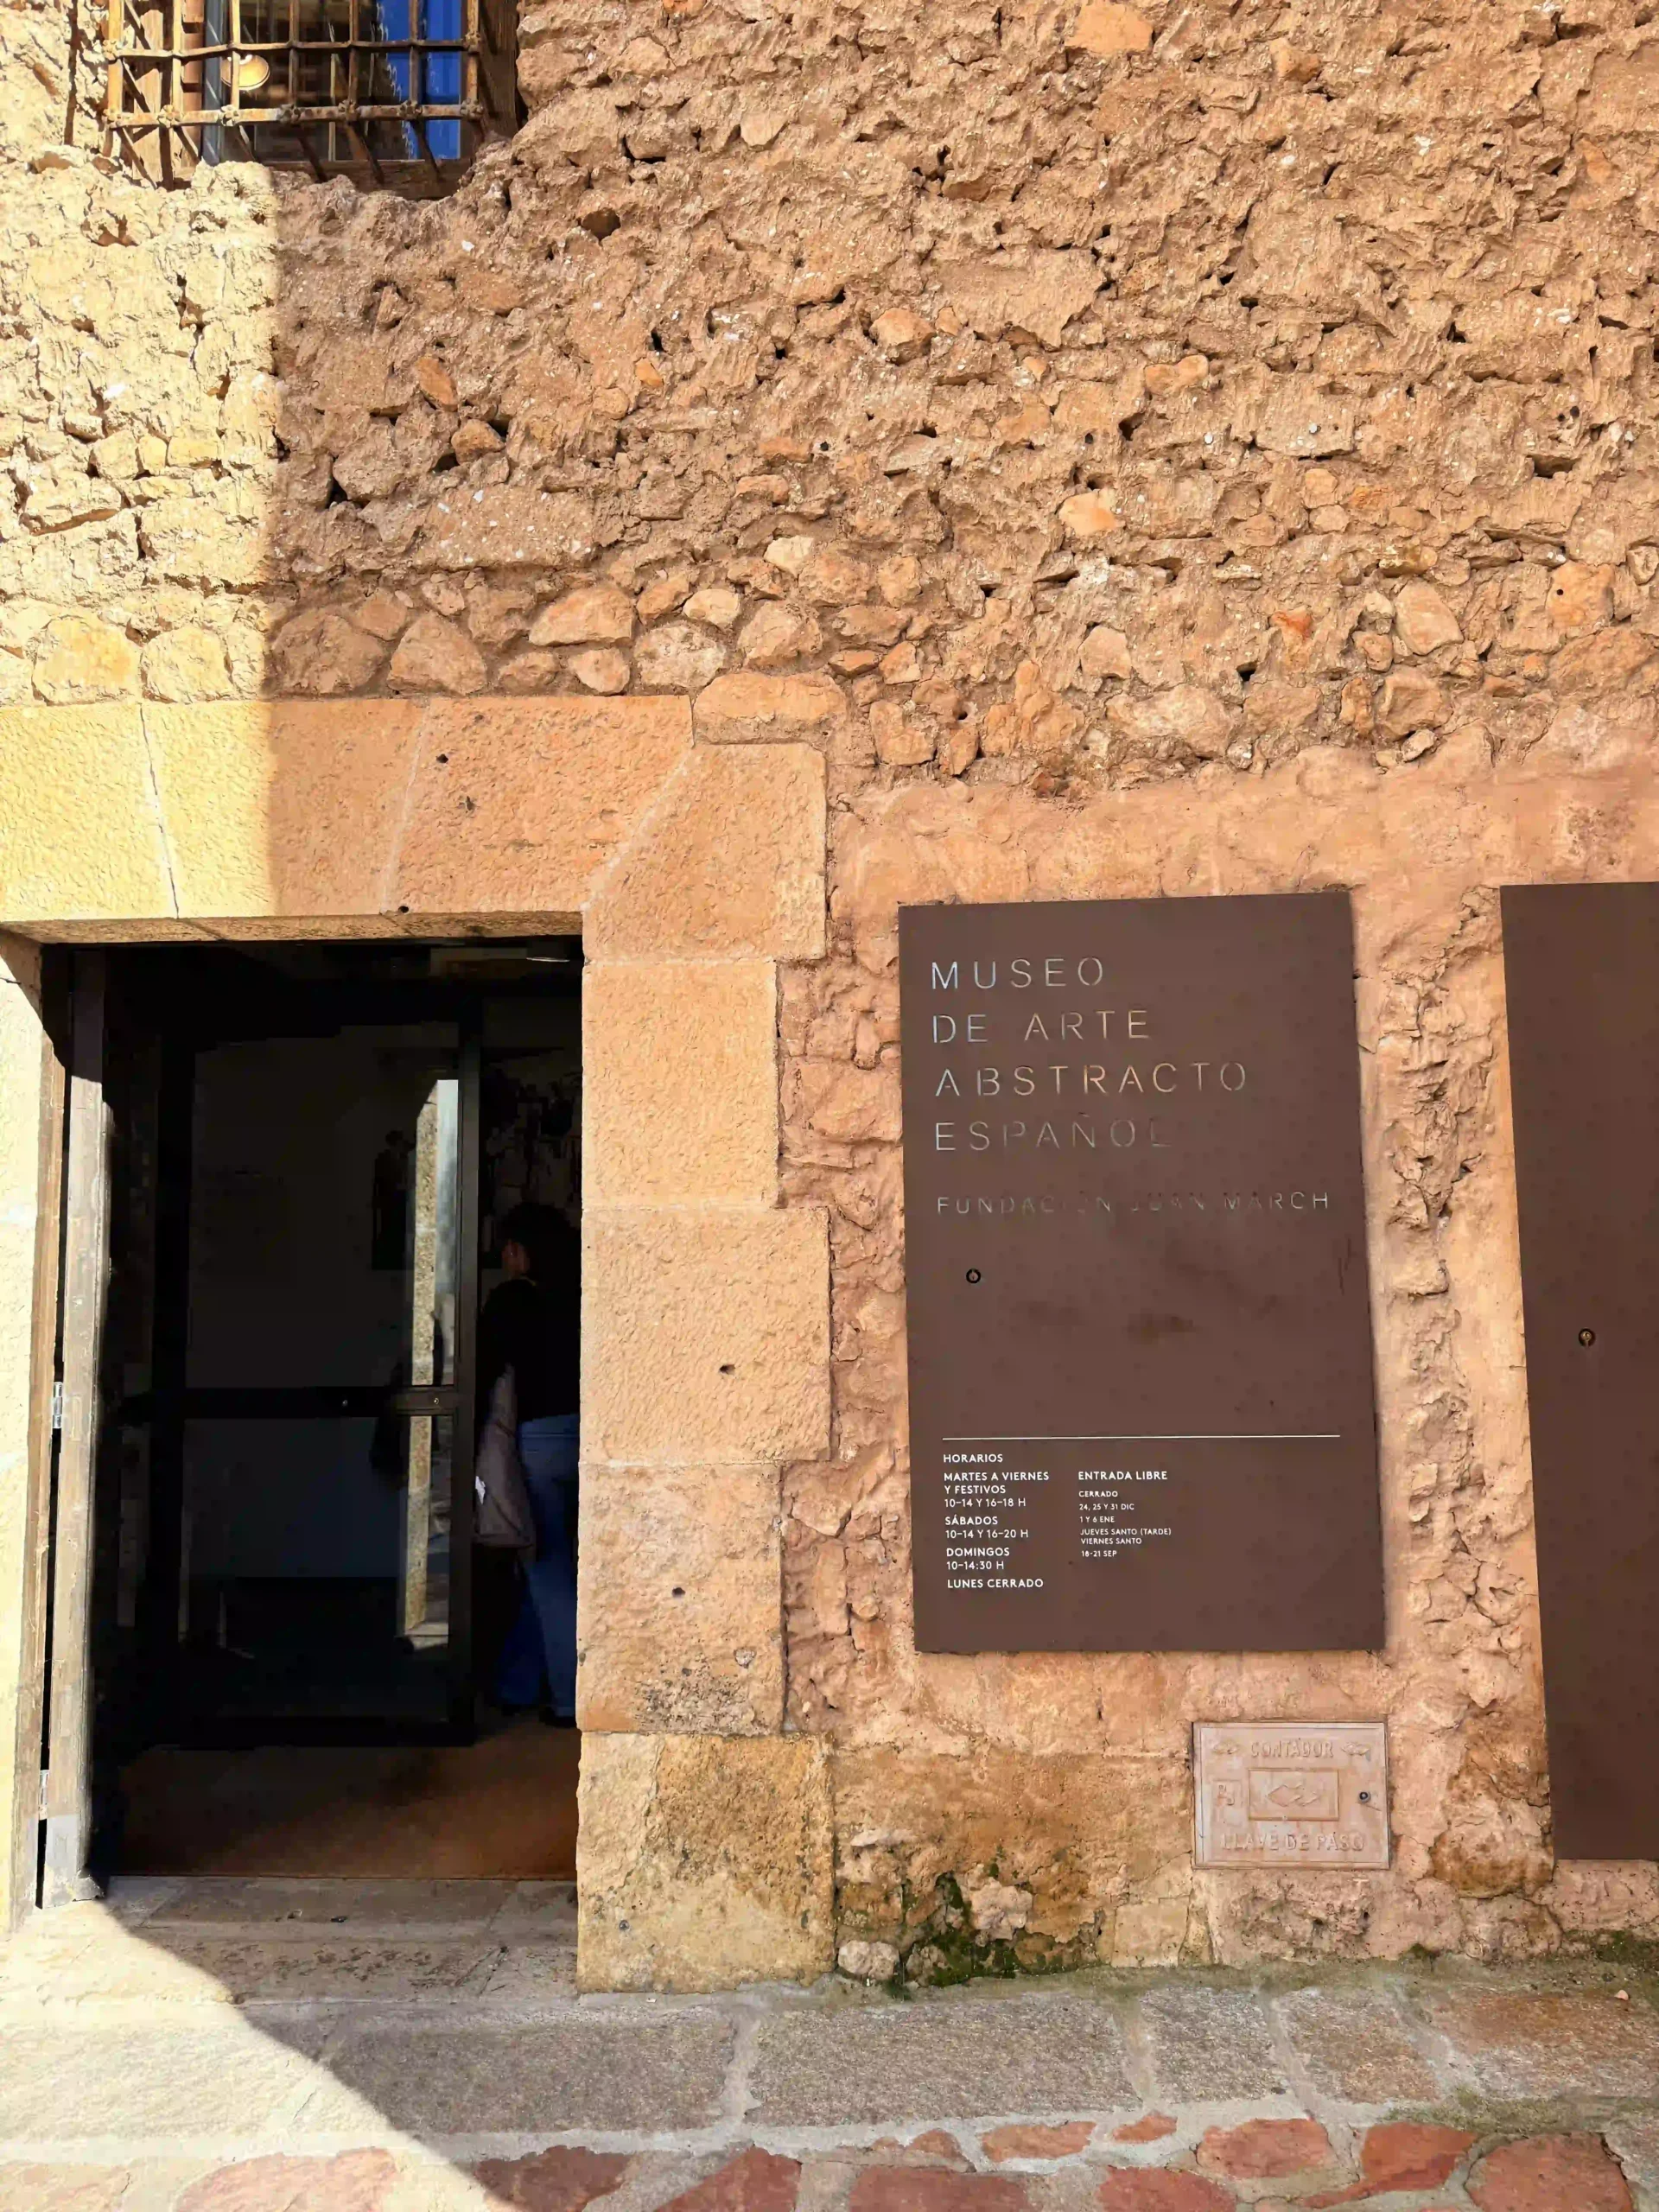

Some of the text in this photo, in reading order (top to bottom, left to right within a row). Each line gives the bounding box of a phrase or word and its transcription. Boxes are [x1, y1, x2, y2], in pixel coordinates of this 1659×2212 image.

[931, 957, 1103, 989] MUSEO
[932, 1010, 1149, 1044] DE ARTE
[935, 1062, 1246, 1096] ABSTRACTO
[935, 1112, 1173, 1151] ESPAÑOL
[937, 1191, 1111, 1215] FUNDACN
[1224, 1191, 1328, 1211] MARCH
[943, 1453, 1004, 1464] HORARIOS
[944, 1471, 988, 1482] MARTES
[1001, 1471, 1050, 1481] VIERNES
[1077, 1471, 1168, 1481] ENTRADA LIBRE
[954, 1484, 1007, 1495] FESTIVOS
[944, 1514, 999, 1526] SÁBADOS
[1140, 1527, 1172, 1536] (TARDE)
[945, 1547, 1010, 1557] DOMINGOS
[1103, 1549, 1117, 1558] SEP
[947, 1578, 1044, 1589] LUNES CERRADO
[1251, 1740, 1333, 1758] CONTADOR
[1222, 1833, 1364, 1851] LLAVE DE PASO
